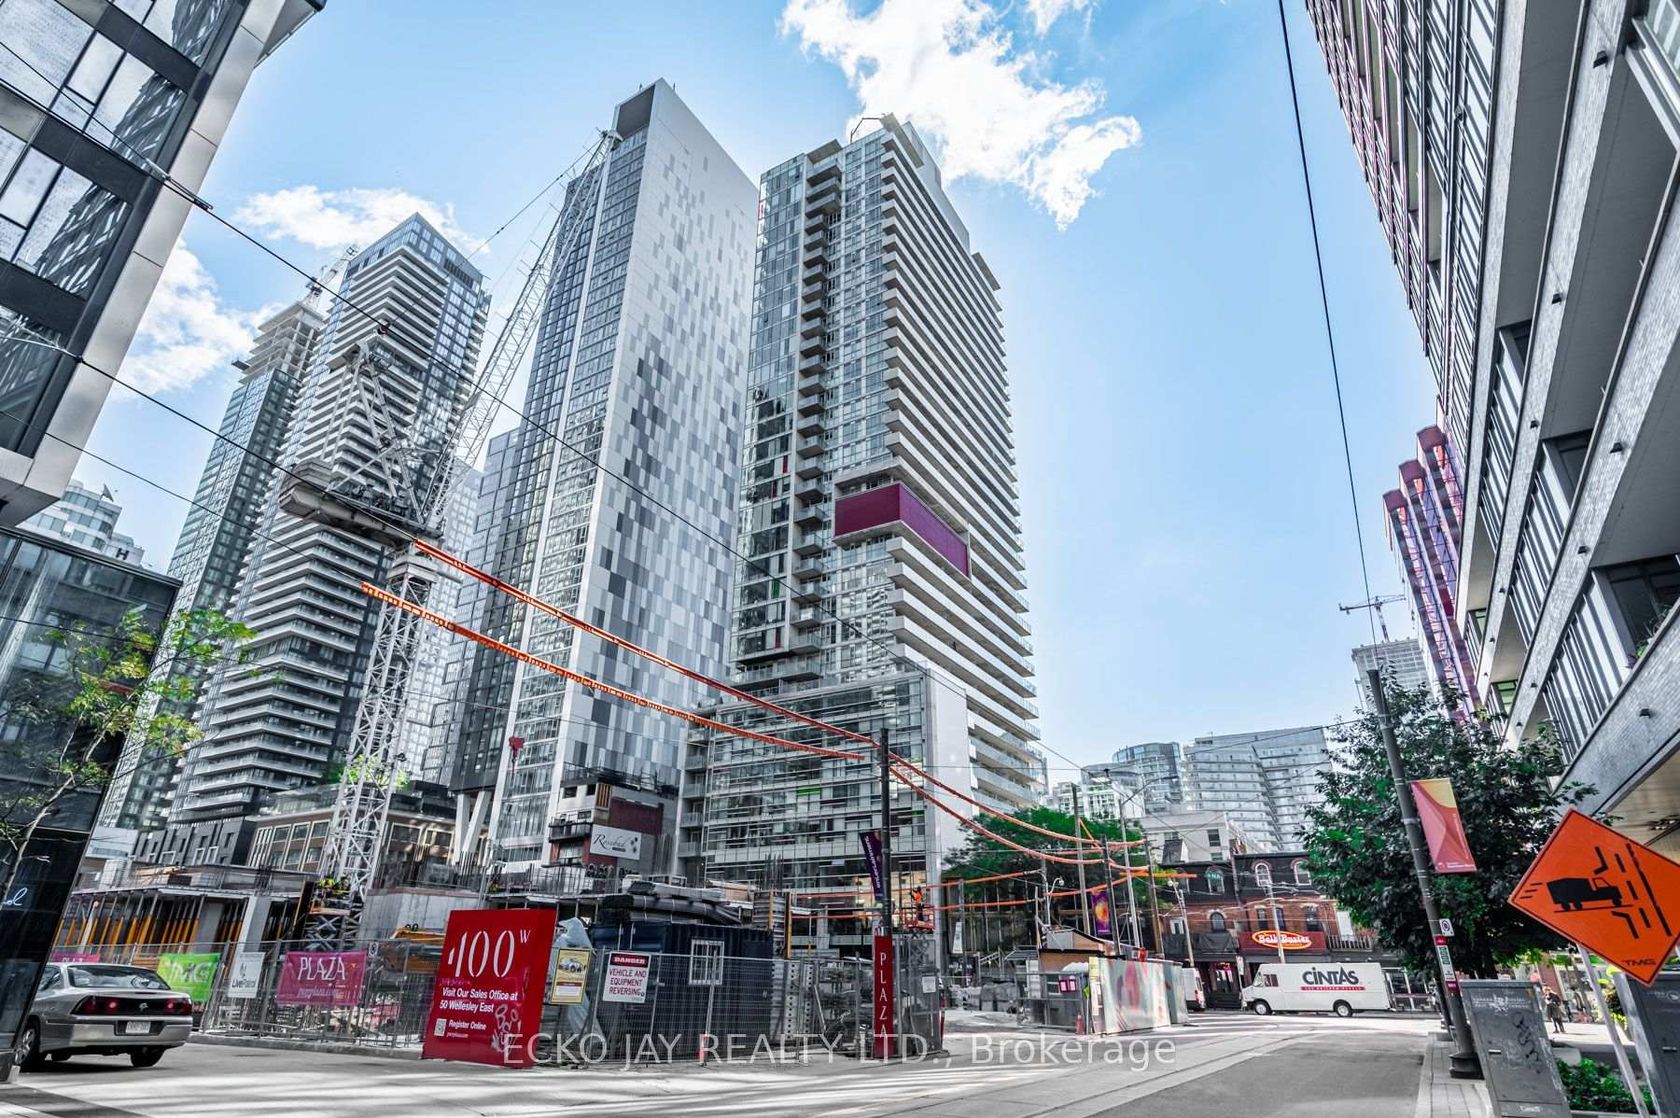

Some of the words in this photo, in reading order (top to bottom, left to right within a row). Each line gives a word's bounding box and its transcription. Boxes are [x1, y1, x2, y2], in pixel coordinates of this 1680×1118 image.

[297, 956, 346, 981] PLAZA
[609, 968, 633, 977] VEHICLE
[634, 970, 647, 978] AND
[610, 978, 642, 987] EQUIPMENT
[442, 986, 456, 997] Visit
[456, 988, 468, 998] Our
[469, 989, 487, 999] Sales
[488, 990, 509, 1001] Office
[510, 992, 518, 1001] at
[608, 987, 641, 996] REVERSING
[879, 952, 889, 1039] PLAZA
[439, 1000, 448, 1009] 50
[448, 1000, 478, 1013] Wellesley
[479, 1002, 494, 1012] East
[449, 1019, 470, 1029] Register
[470, 1021, 487, 1030] Online
